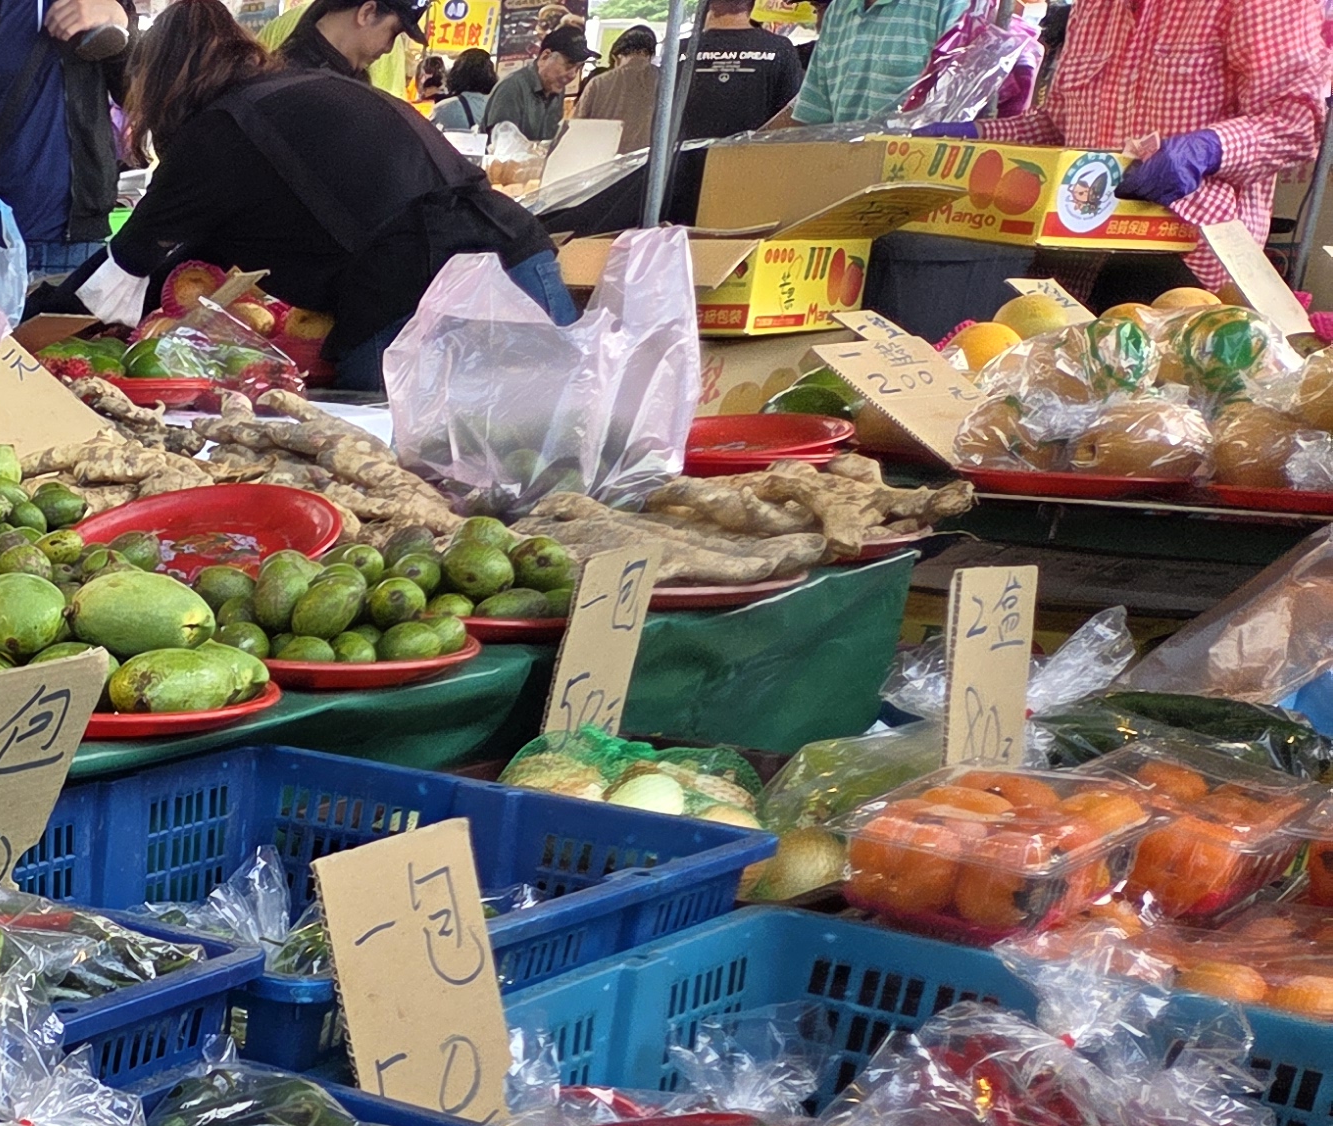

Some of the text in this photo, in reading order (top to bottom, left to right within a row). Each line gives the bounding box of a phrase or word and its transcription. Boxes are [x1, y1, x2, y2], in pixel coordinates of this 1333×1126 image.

[679, 51, 776, 61] AERICAN DREAM
[930, 205, 997, 230] Mango
[806, 302, 841, 326] Mang
